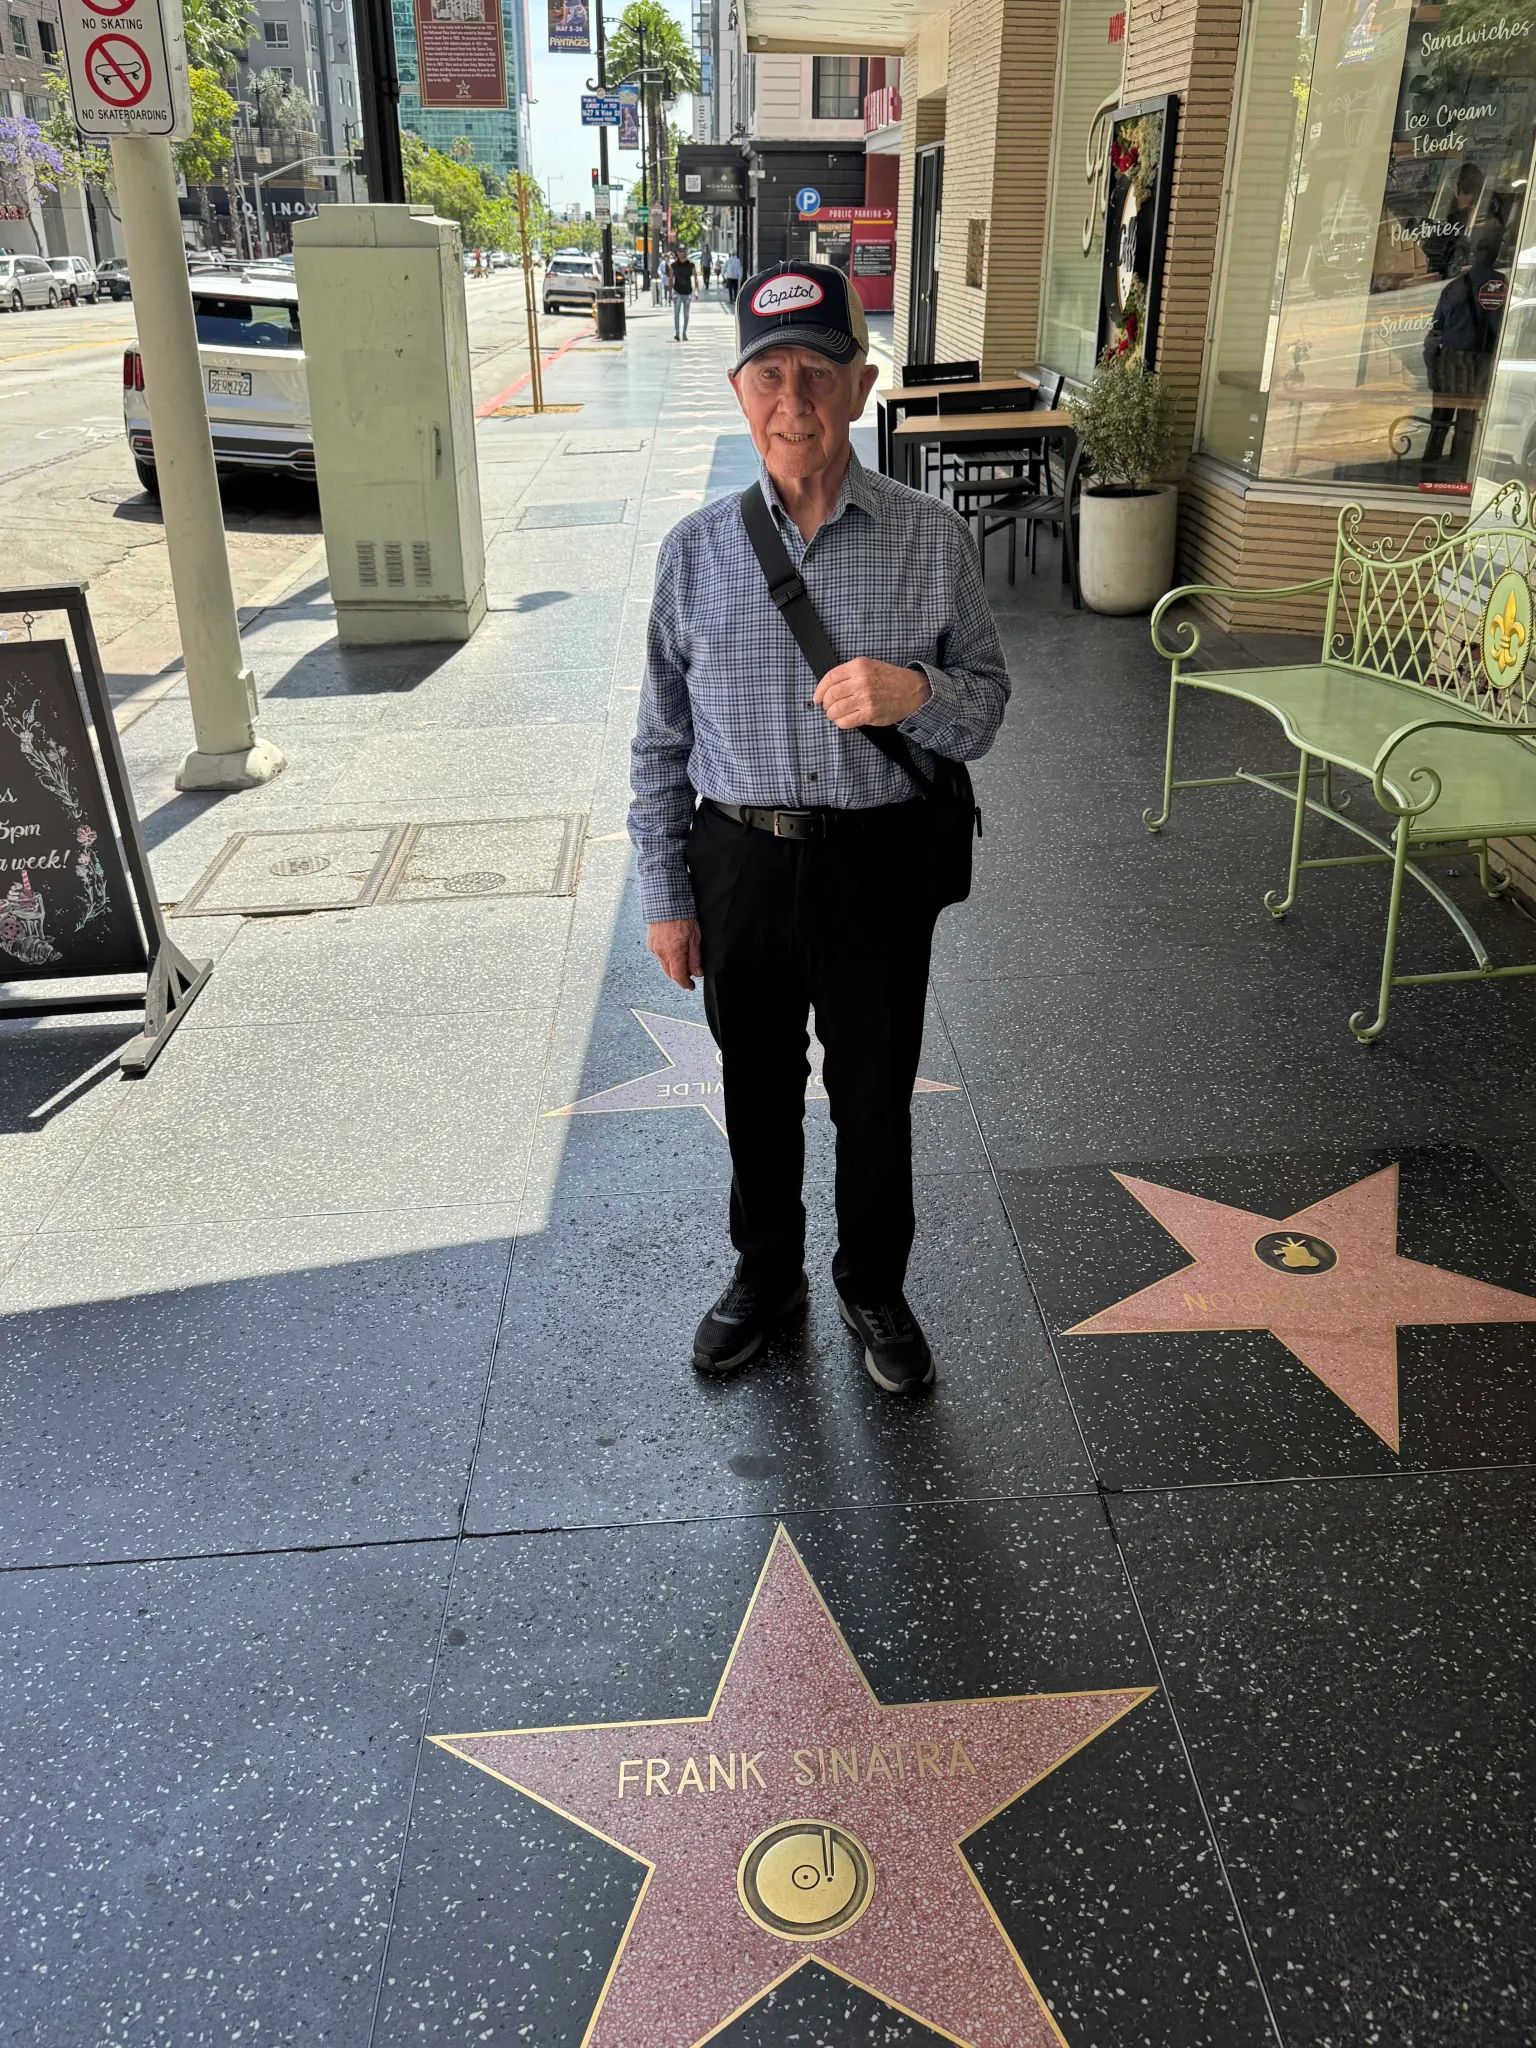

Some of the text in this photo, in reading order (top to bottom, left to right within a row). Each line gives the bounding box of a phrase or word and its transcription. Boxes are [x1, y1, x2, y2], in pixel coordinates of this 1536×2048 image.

[82, 18, 143, 30] NO SKATING
[549, 37, 589, 47] PANTAGES
[1420, 17, 1536, 57] Sandwiches
[82, 109, 168, 120] NO SKATEBOARDING
[697, 104, 709, 145] ington
[1404, 103, 1497, 132] Ice Cream
[1412, 130, 1468, 158] Floats
[803, 192, 817, 210] P
[828, 209, 882, 218] PUBLIC PARKING
[1391, 220, 1464, 247] Pastries
[759, 285, 814, 308] Capitol
[1379, 312, 1439, 338] Salads
[1433, 482, 1468, 490] DOORDASH
[11, 849, 71, 870] week!
[617, 1740, 977, 1799] FRANK SINATRA
